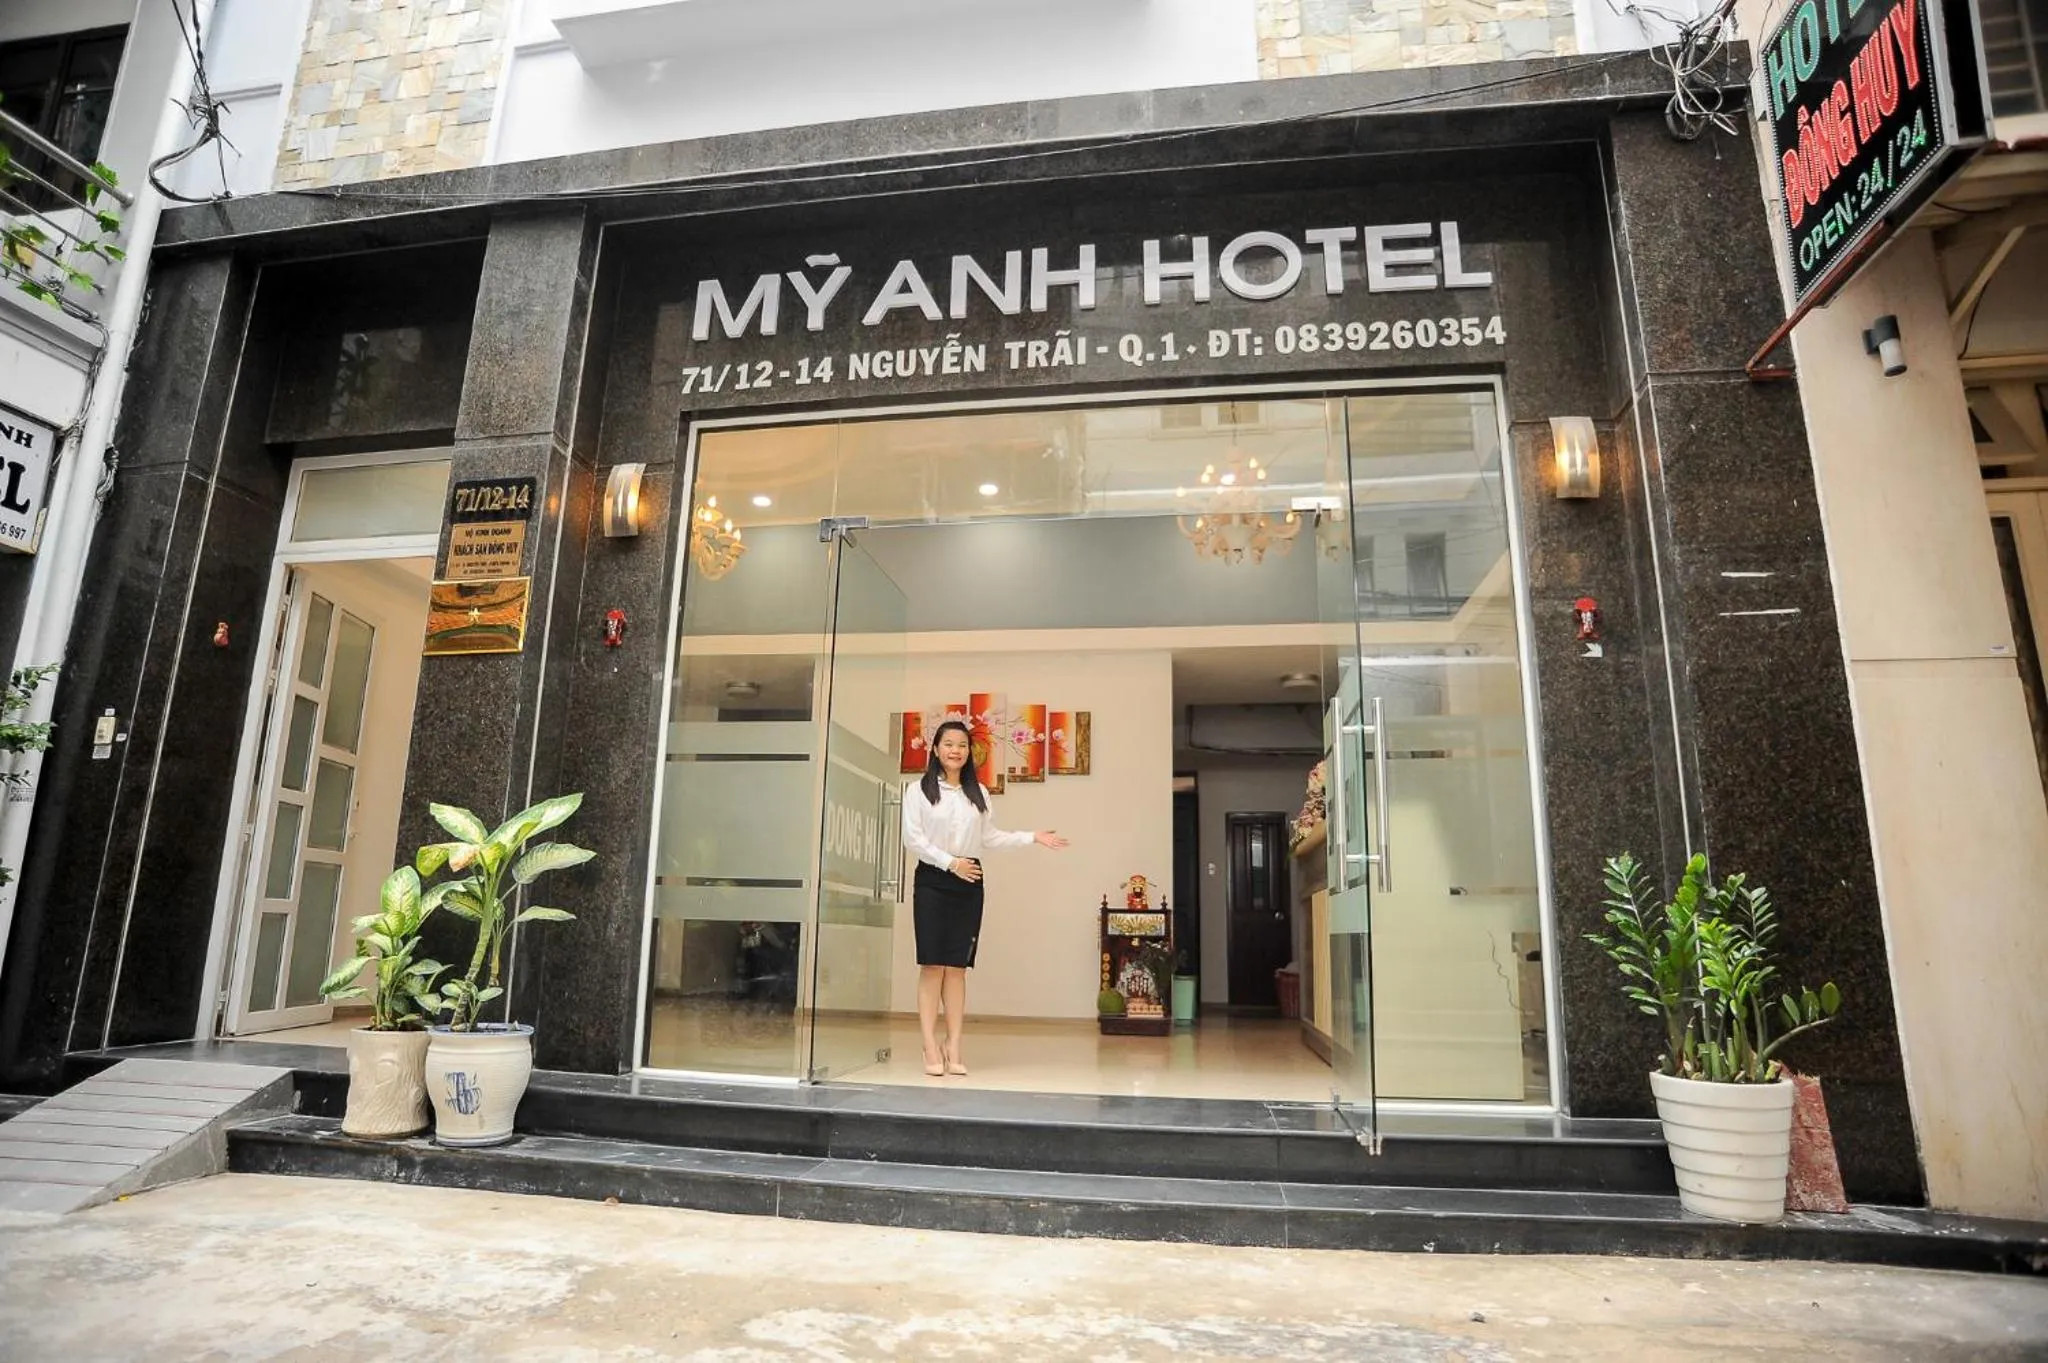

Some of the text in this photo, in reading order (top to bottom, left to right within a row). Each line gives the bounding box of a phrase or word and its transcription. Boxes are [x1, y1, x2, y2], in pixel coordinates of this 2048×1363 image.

[1850, 0, 1920, 144] HUY
[691, 220, 1493, 341] MỸ ANH HOTEL
[847, 332, 986, 381] NGUYỄN
[1207, 327, 1264, 358] ĐT:
[1274, 316, 1507, 355] 0839260354
[455, 484, 530, 512] 71/12-14
[9, 524, 27, 541] 997
